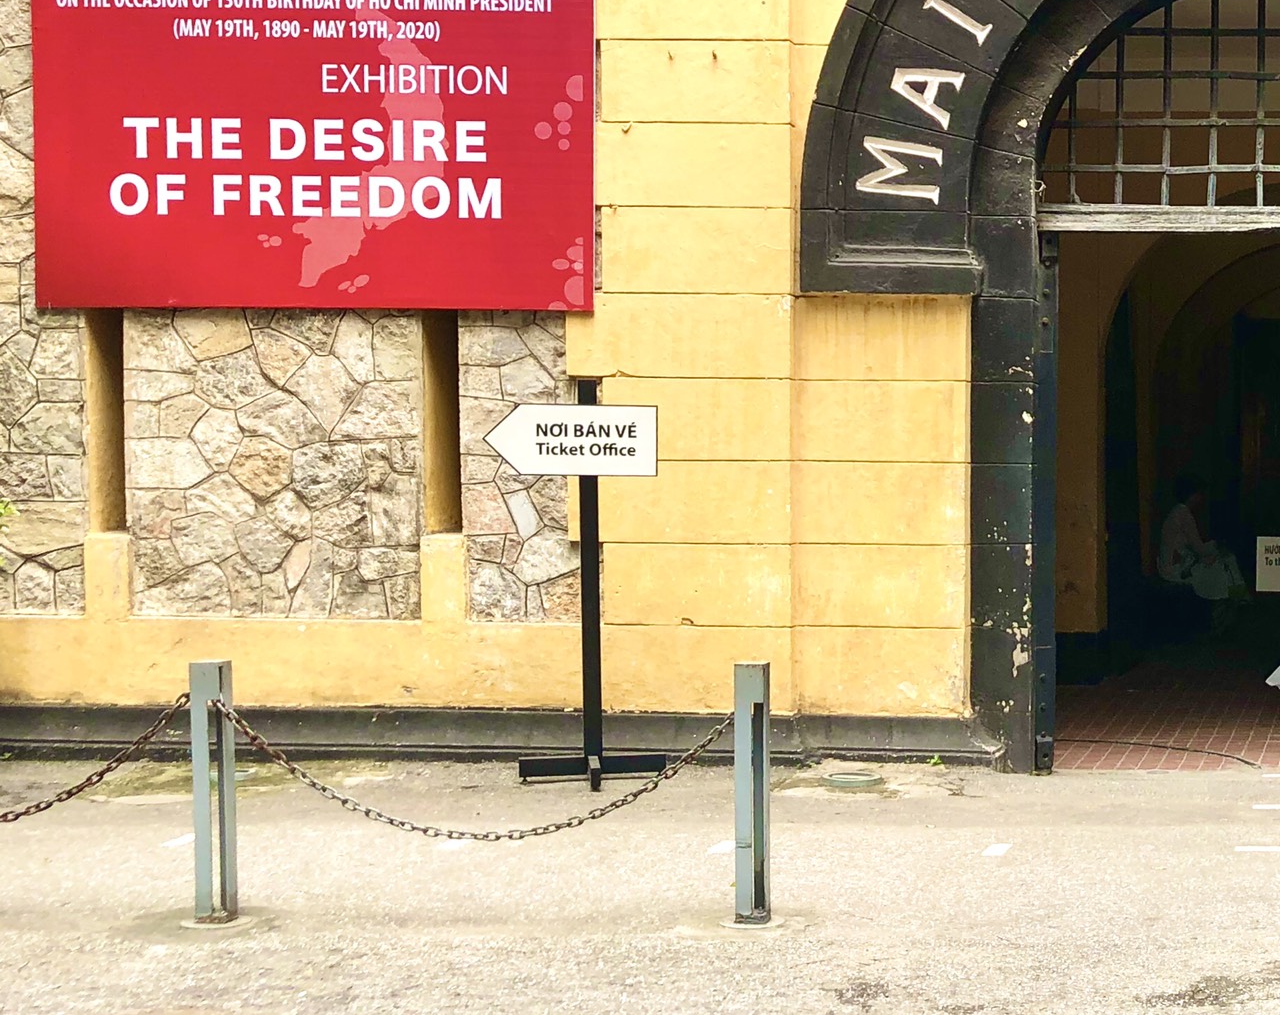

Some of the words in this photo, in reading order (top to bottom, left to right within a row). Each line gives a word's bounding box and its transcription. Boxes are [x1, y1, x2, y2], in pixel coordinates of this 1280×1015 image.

[173, 18, 212, 40] (MAY
[215, 19, 259, 40] 19TH,
[262, 20, 301, 38] 1890
[313, 20, 346, 38] MAY
[349, 20, 393, 42] 19TH,
[396, 20, 441, 42] 2020)
[322, 64, 508, 95] EXHIBITION
[123, 117, 243, 160] THE
[269, 118, 487, 162] DESIRE
[109, 173, 186, 216] OF
[212, 174, 502, 219] FREEDOM
[536, 422, 568, 438] NƠI
[573, 421, 611, 438] BÁN
[615, 421, 637, 439] VÉ
[535, 442, 585, 456] Ticket
[589, 442, 636, 457] Office
[1265, 557, 1273, 566] To
